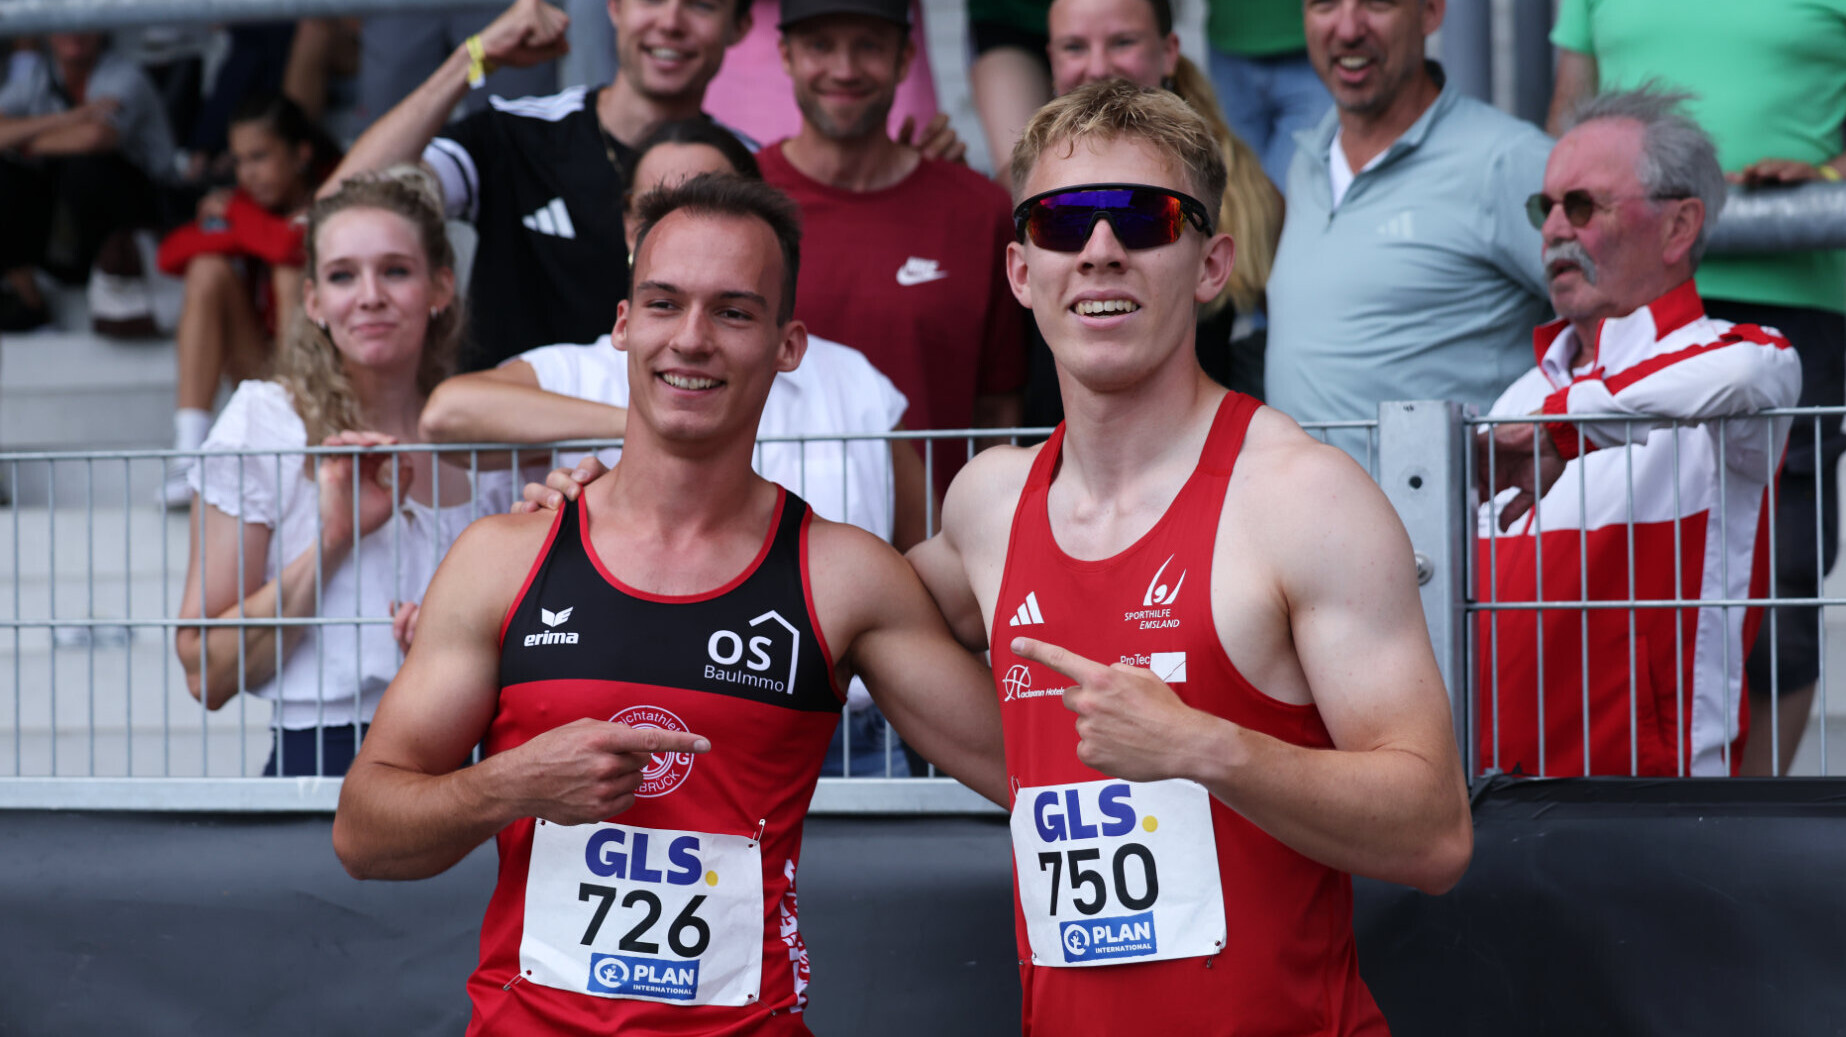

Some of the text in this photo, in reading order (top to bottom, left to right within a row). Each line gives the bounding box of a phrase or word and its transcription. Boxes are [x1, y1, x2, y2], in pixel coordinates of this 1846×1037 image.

[1124, 608, 1171, 622] SPORTHILFE
[1139, 619, 1180, 630] EMSLAND
[523, 629, 580, 647] erima
[707, 629, 773, 672] OS
[704, 664, 784, 693] BauImmo
[634, 769, 681, 793] BRÜCK
[1038, 842, 1159, 917] 750
[578, 882, 711, 958] 726
[1092, 921, 1151, 944] PLAN
[1095, 943, 1153, 954] INTERNATIONAL
[633, 964, 695, 986] PLAN
[633, 984, 693, 995] INTERNATIONAL
